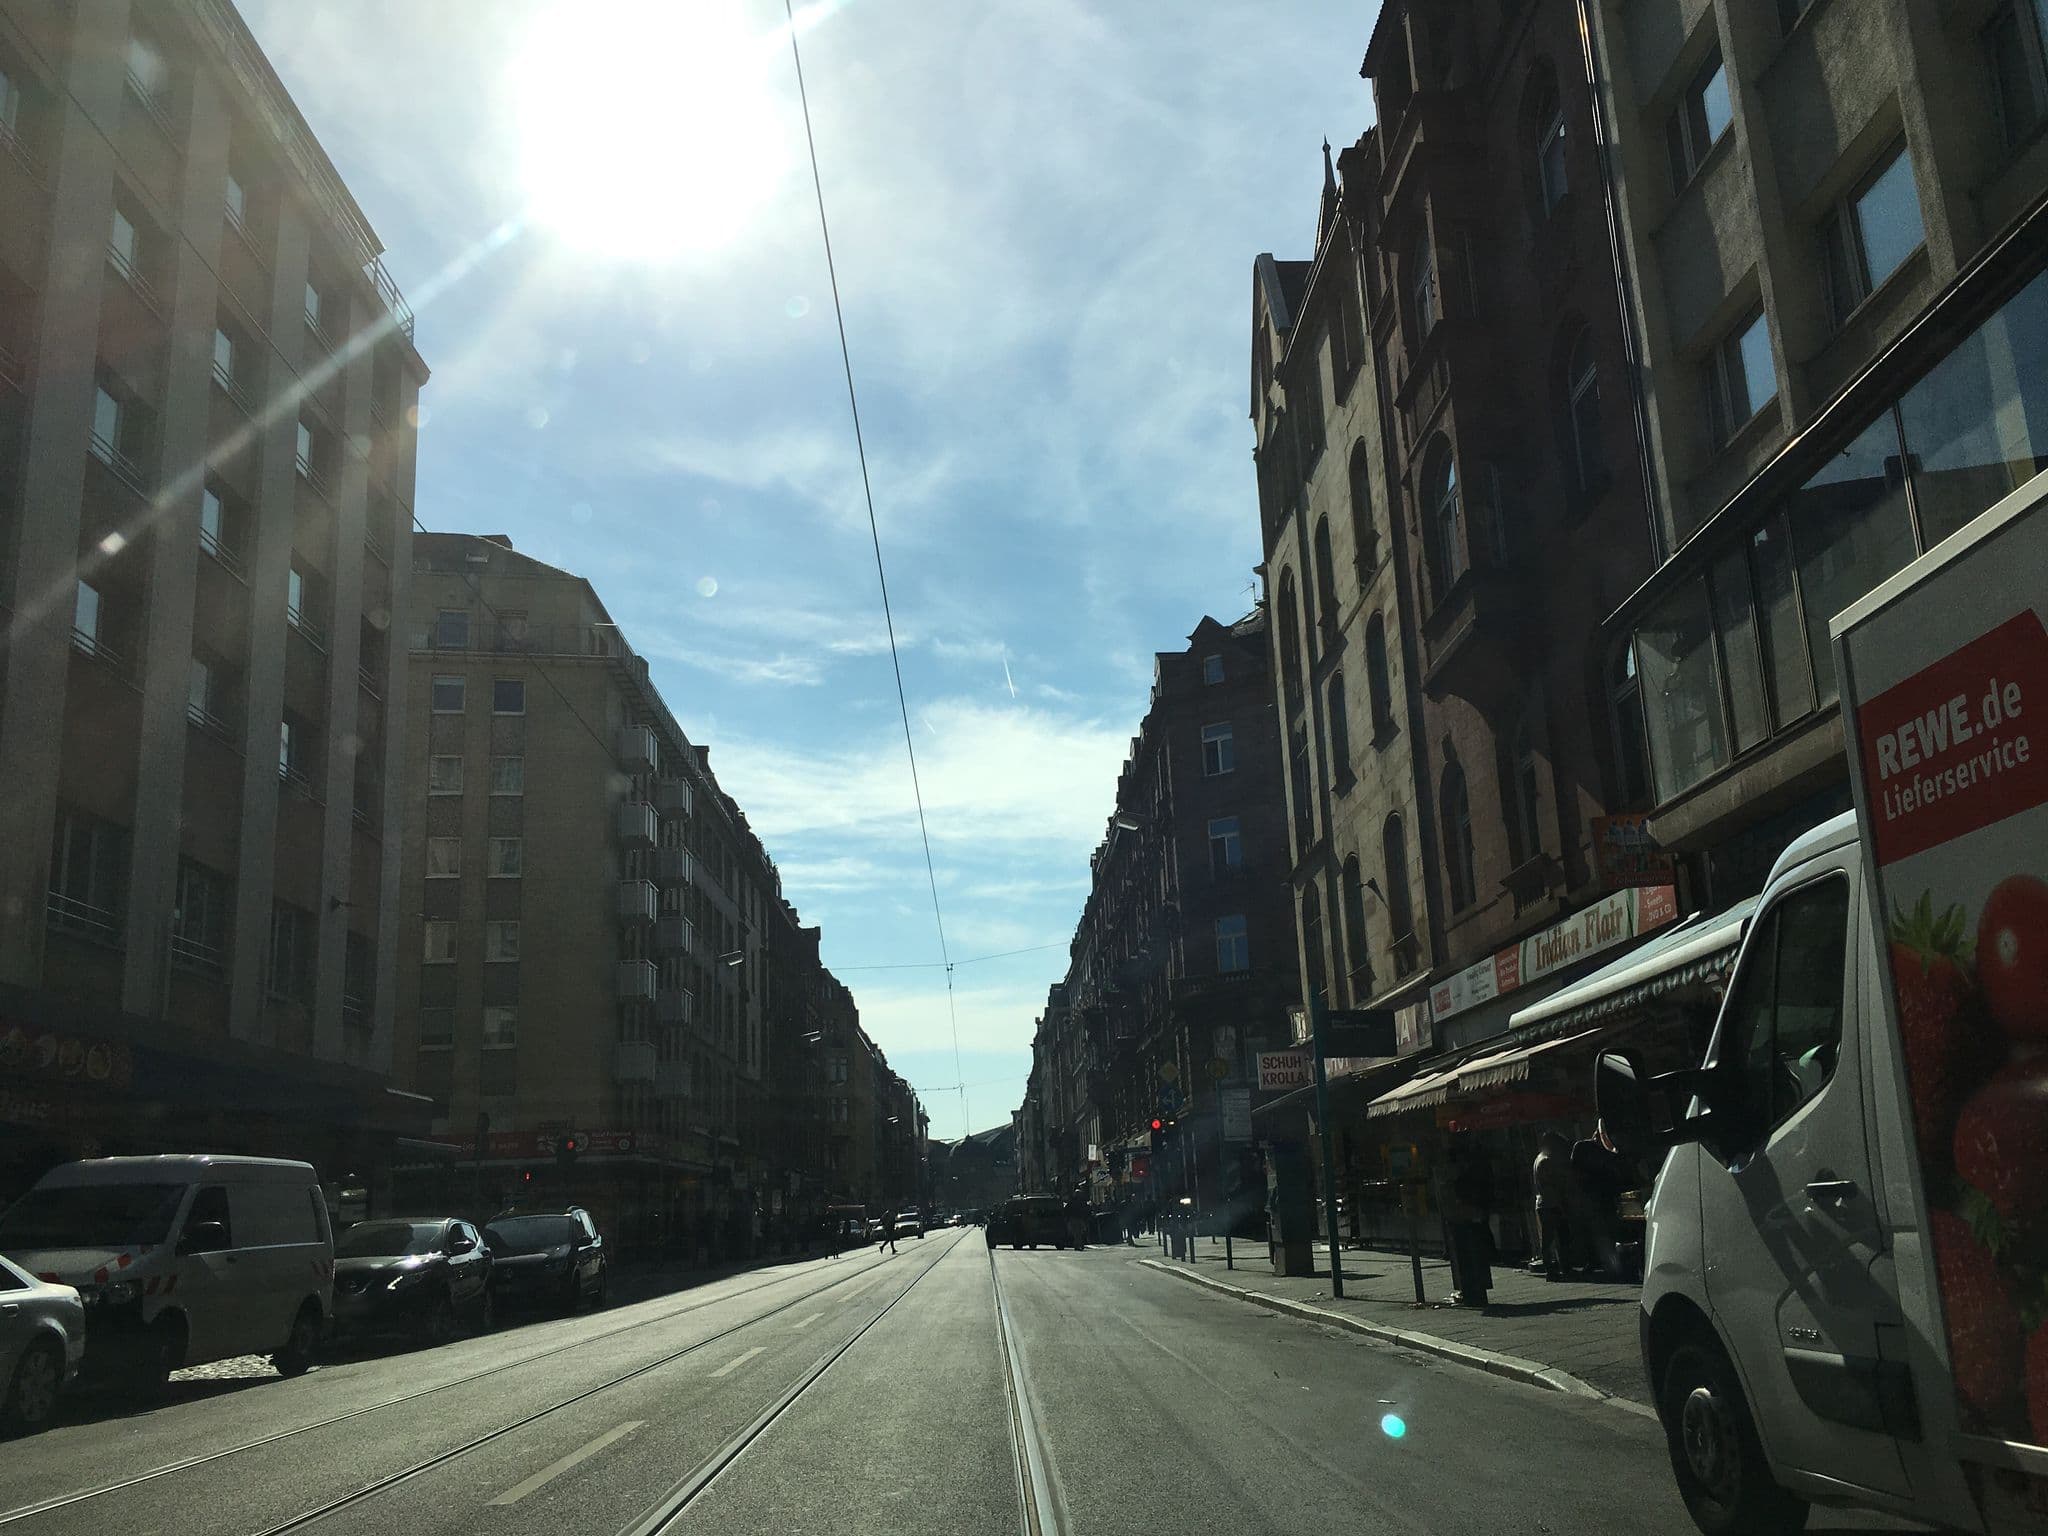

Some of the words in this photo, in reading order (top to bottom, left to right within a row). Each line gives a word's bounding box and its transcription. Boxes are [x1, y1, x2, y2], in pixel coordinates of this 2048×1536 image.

[1876, 677, 2022, 780] REWE.de
[1883, 736, 2030, 821] Lieferservice
[1535, 926, 1580, 972] Indian
[1584, 900, 1624, 948] Flair
[1262, 1055, 1301, 1069] SCHUH
[1262, 1071, 1304, 1086] KROLLA
